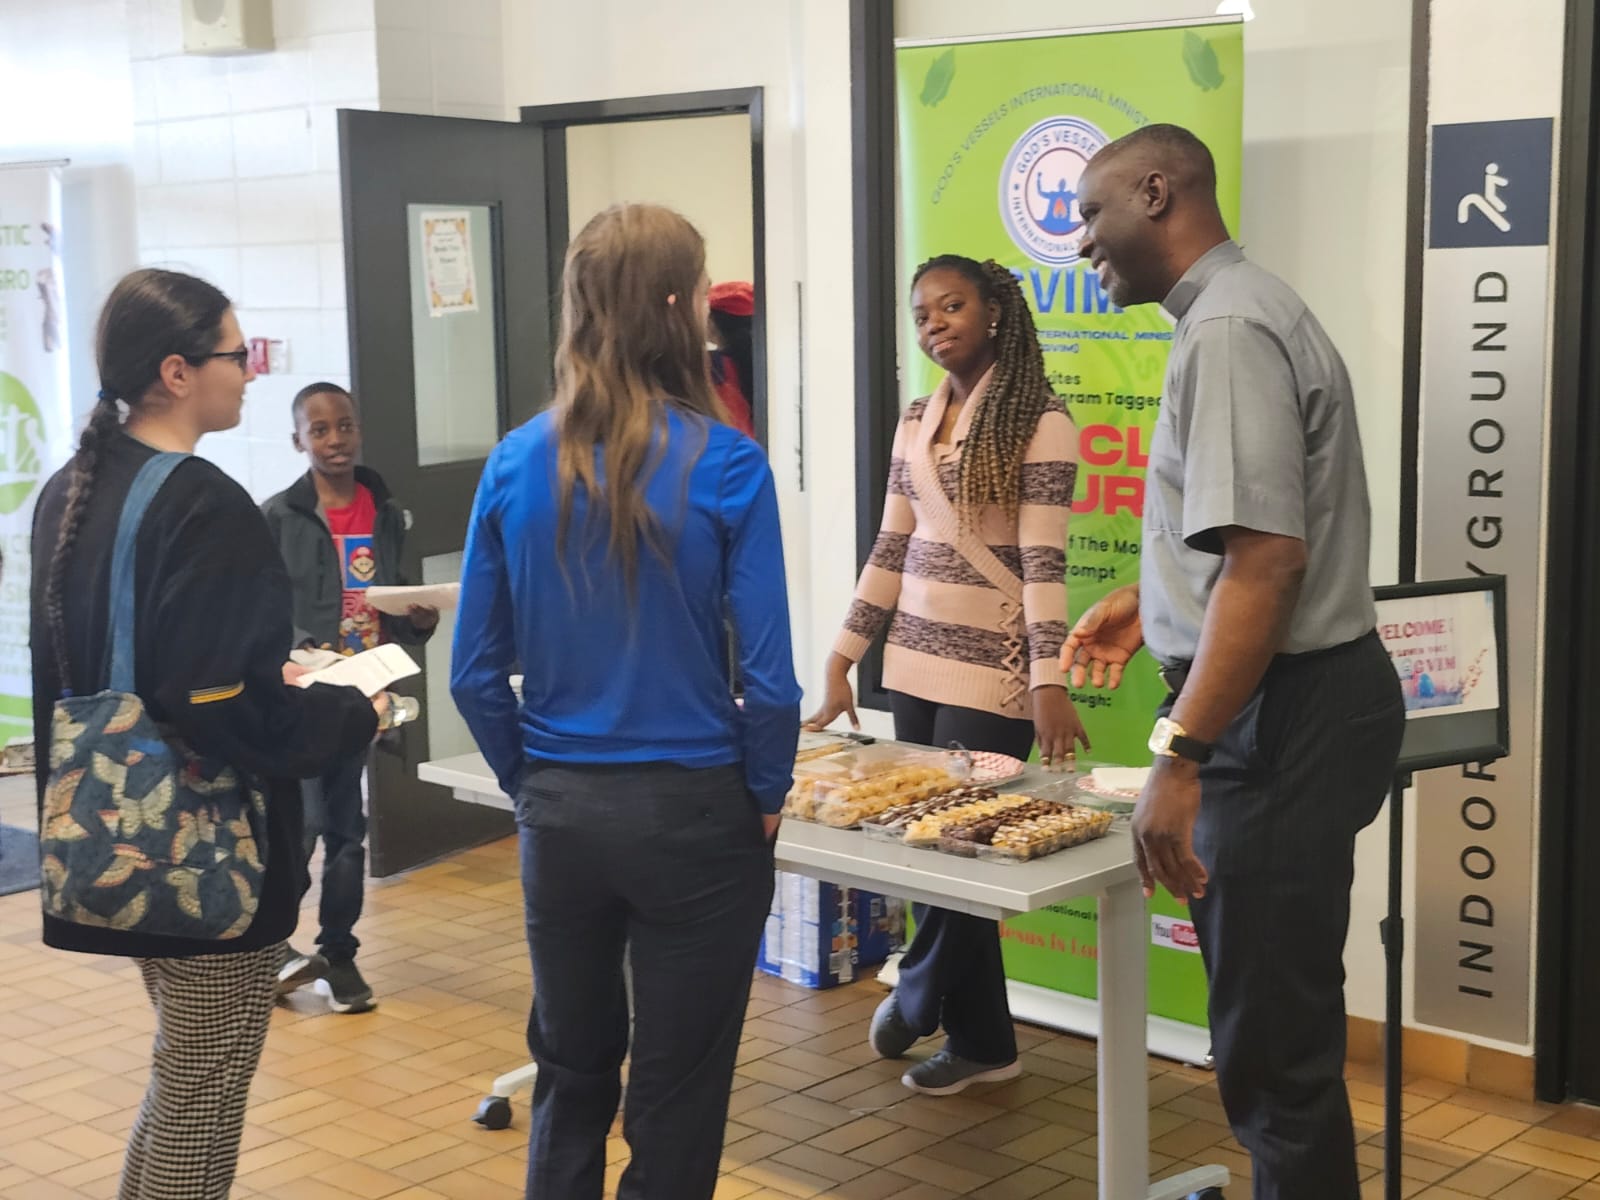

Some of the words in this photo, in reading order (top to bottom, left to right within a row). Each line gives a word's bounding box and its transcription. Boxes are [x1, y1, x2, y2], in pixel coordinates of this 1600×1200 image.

[961, 104, 1008, 151] VESSELS
[1010, 83, 1104, 110] INTERNATIONAL
[1016, 134, 1051, 173] GOD'S
[0, 224, 31, 246] TIC
[1012, 268, 1124, 314] VIM
[1078, 536, 1110, 552] The
[1114, 540, 1142, 555] Mo
[1458, 758, 1497, 999] INDOOR
